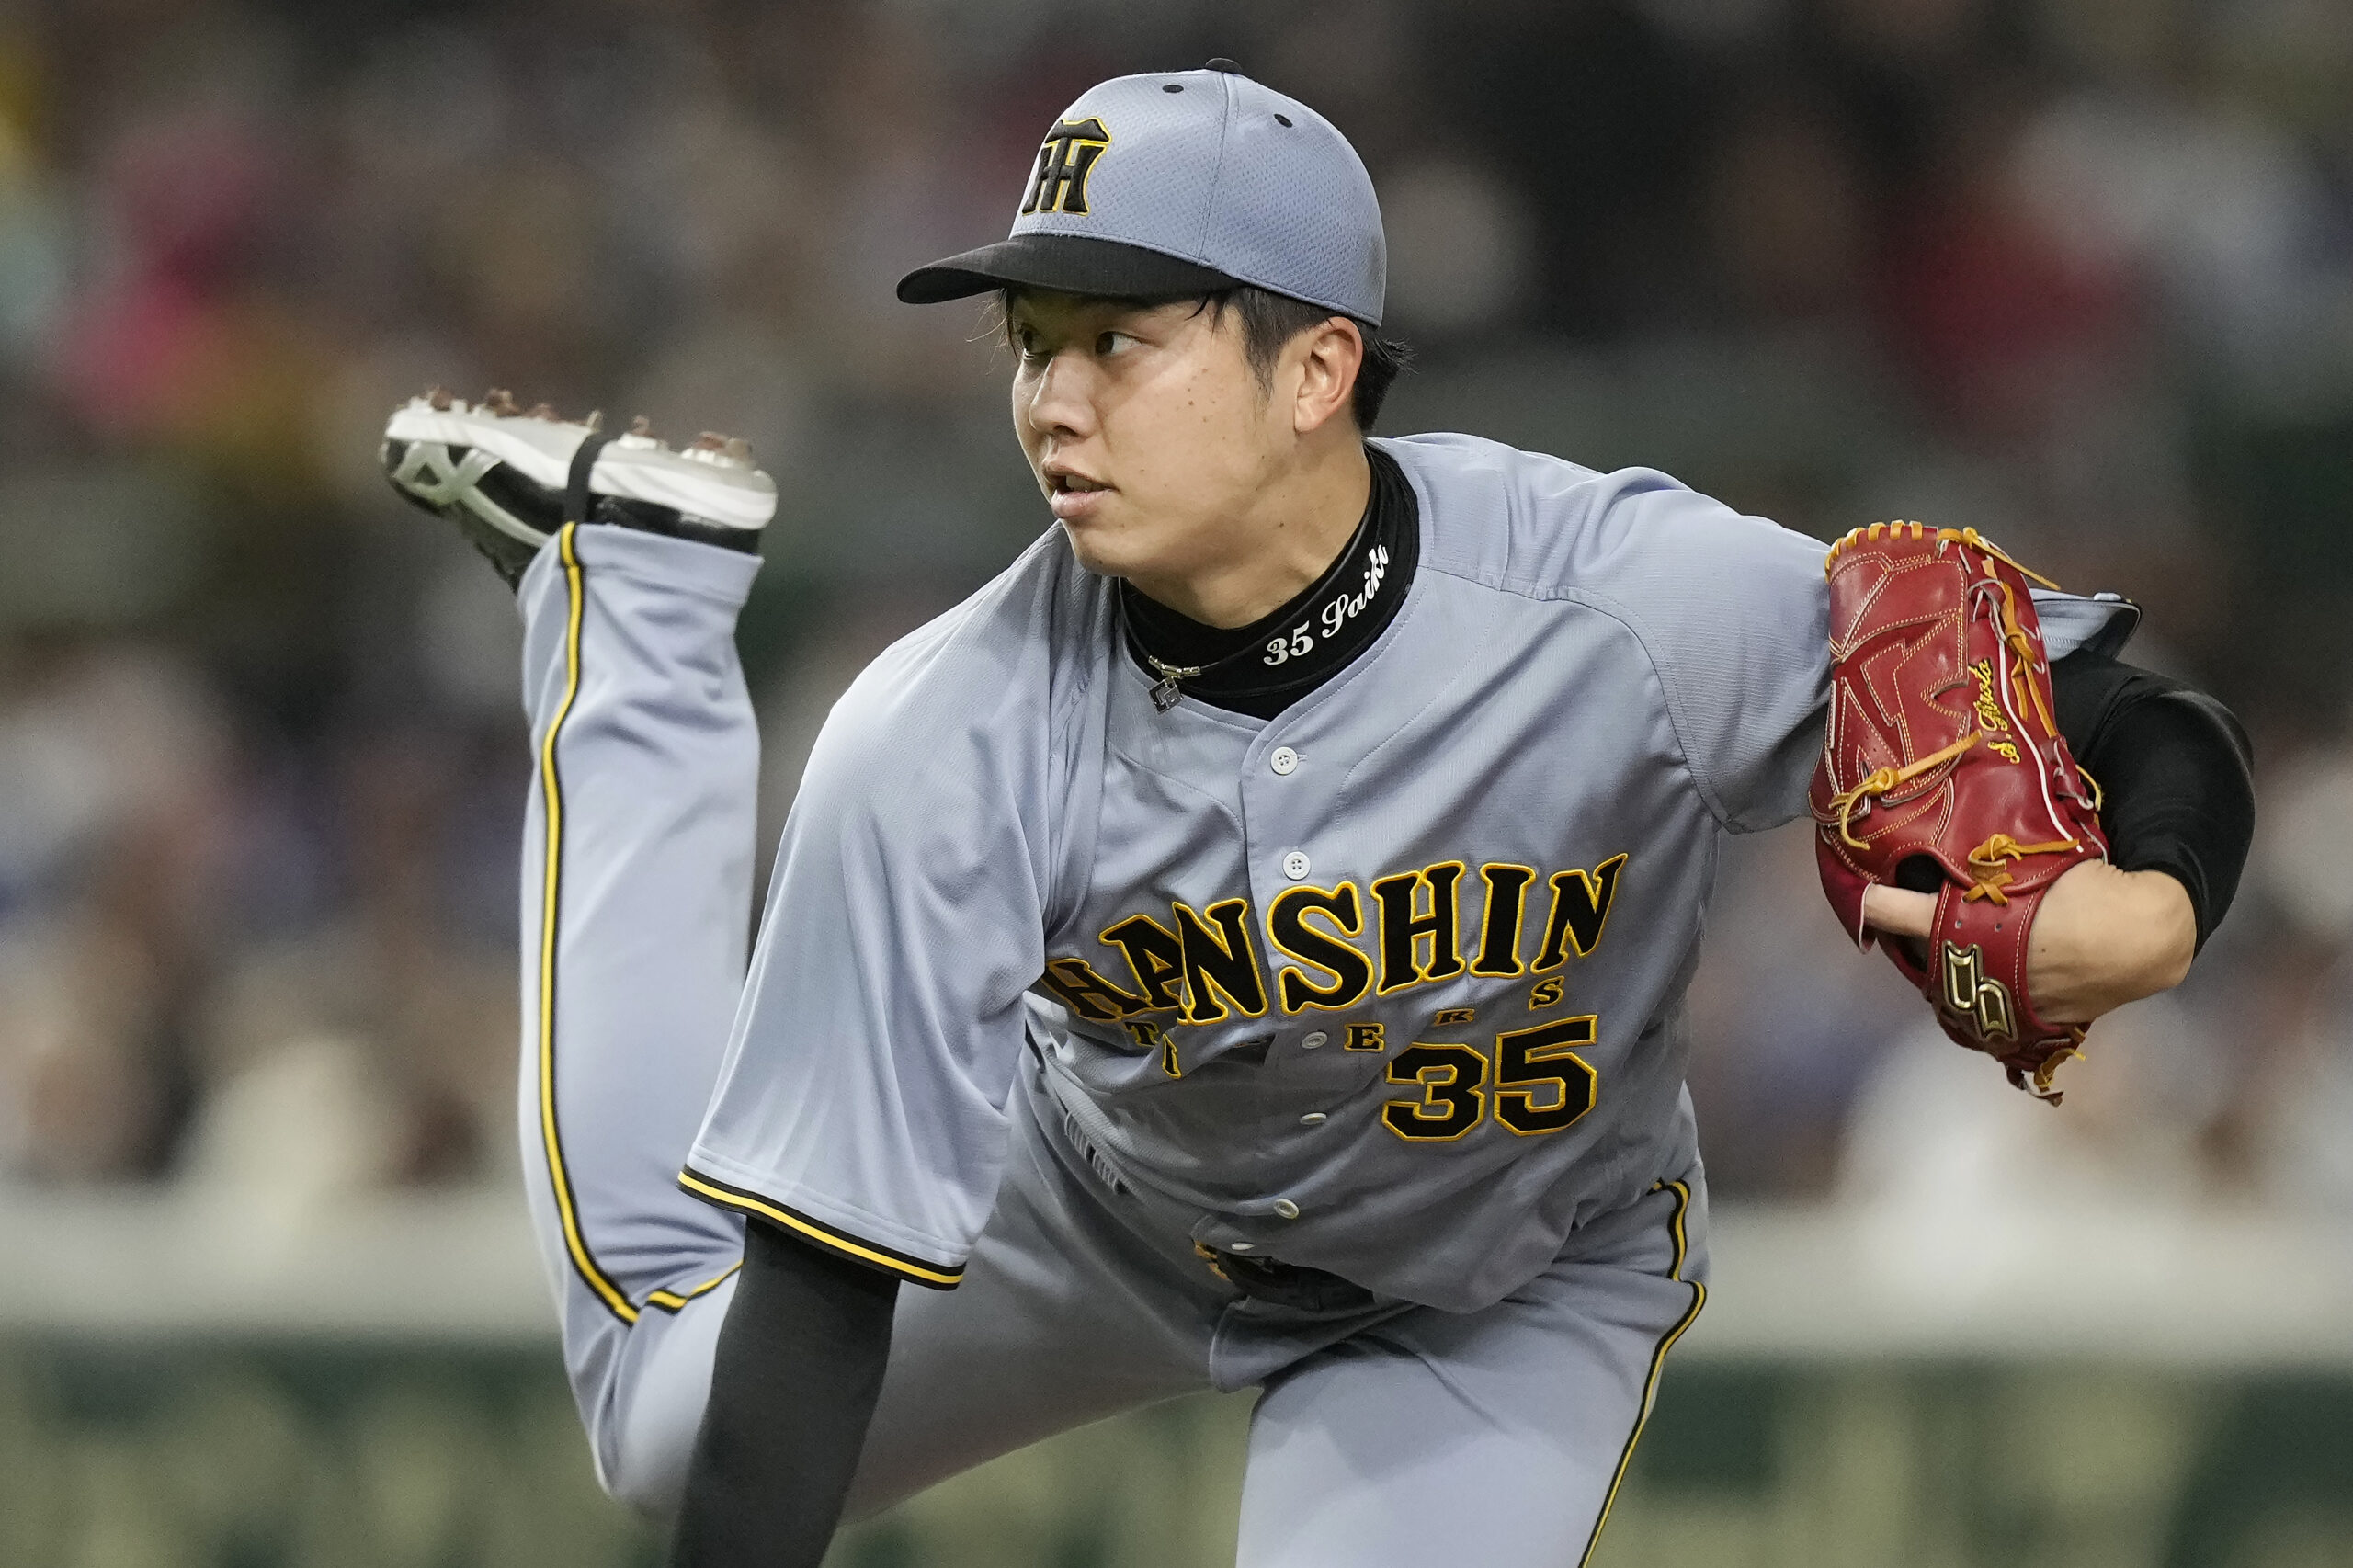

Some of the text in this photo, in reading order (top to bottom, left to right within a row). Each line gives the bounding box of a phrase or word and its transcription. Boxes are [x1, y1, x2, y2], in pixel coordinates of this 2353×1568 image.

[1263, 619, 1314, 665] 35
[1043, 852, 1629, 1028] HANSHIN
[1381, 1014, 1599, 1142] 35
